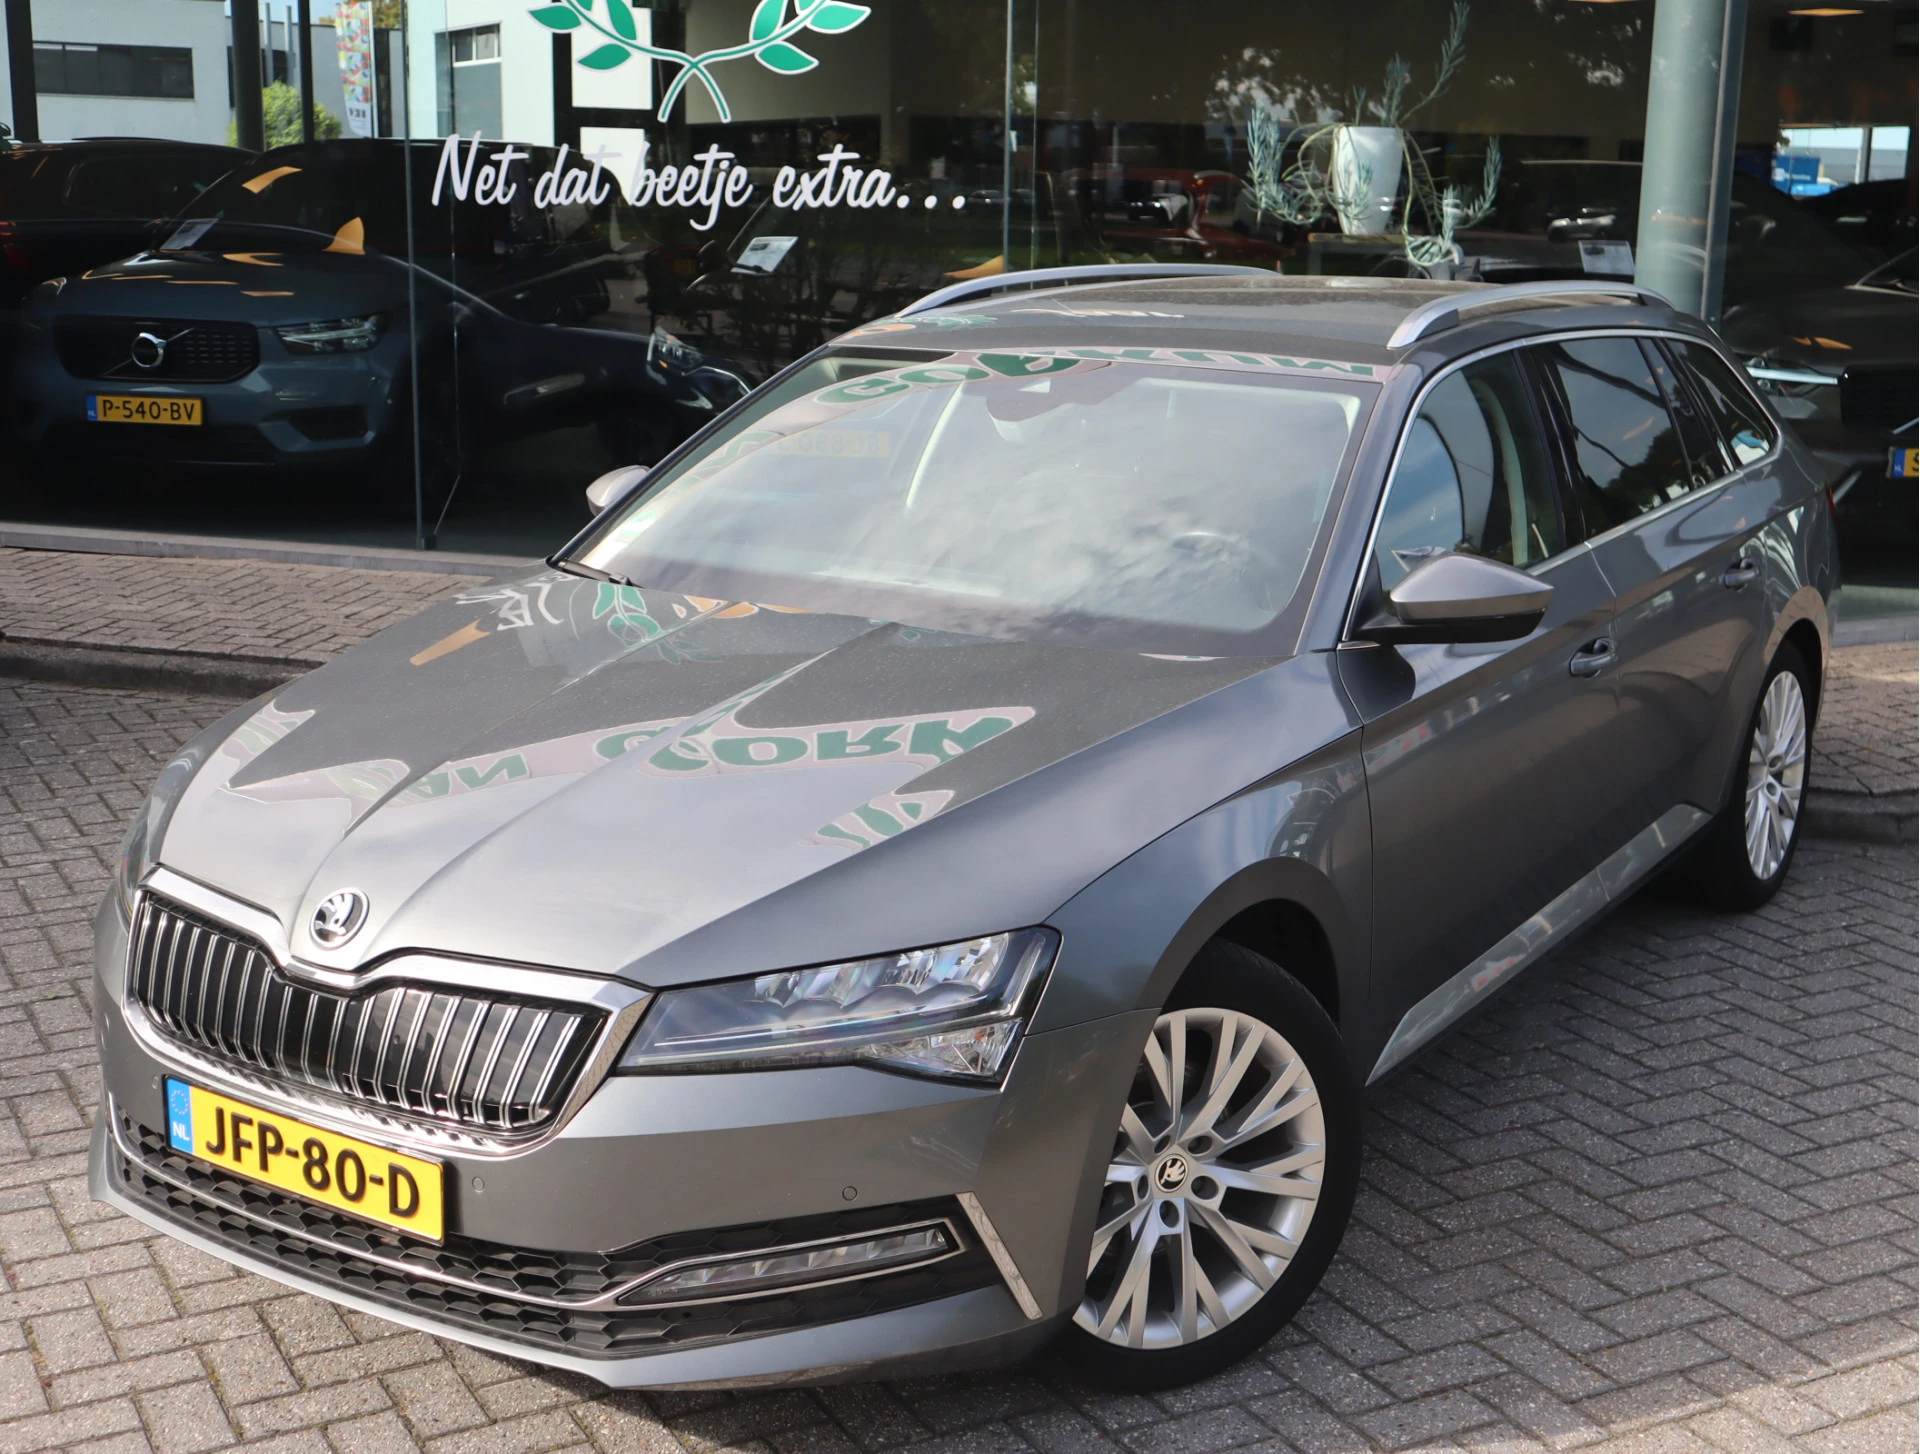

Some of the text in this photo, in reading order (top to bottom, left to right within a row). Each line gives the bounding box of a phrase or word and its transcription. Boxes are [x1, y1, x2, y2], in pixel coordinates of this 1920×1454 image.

[431, 130, 967, 231] Net dat beetje extra...
[102, 398, 195, 421] P-540-BV
[172, 1120, 191, 1142] NL
[205, 1106, 421, 1218] JFP-80-D
